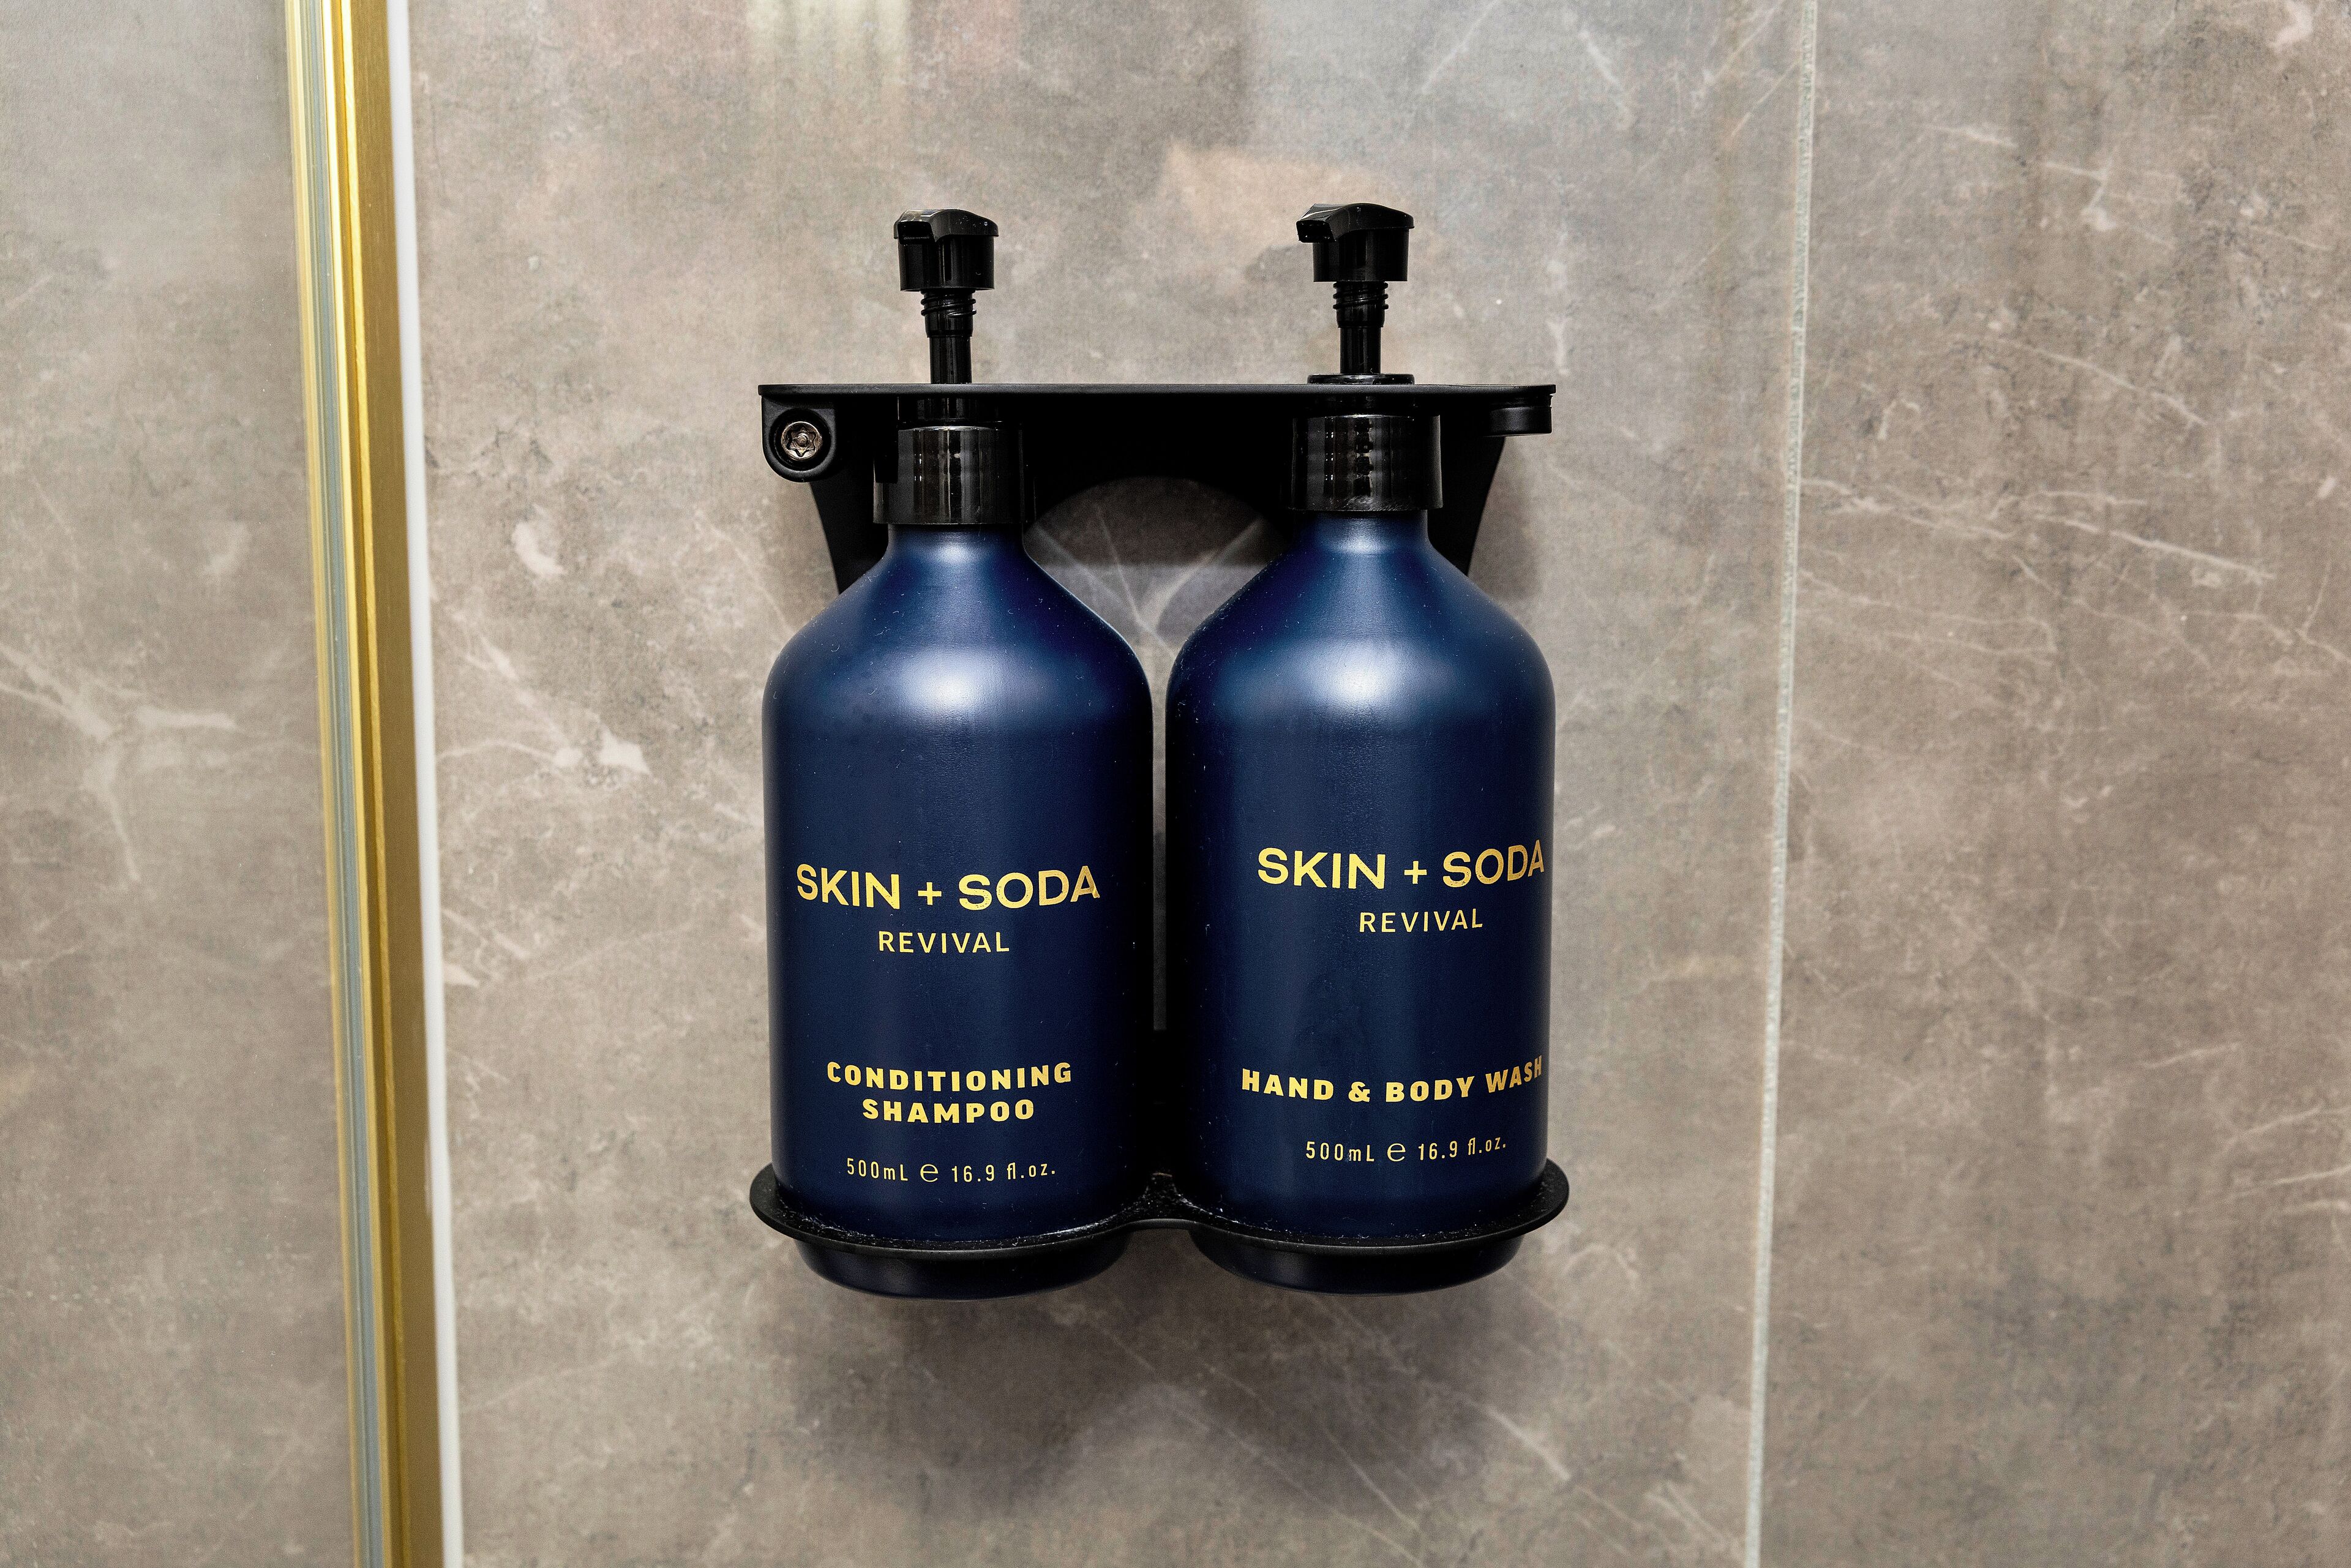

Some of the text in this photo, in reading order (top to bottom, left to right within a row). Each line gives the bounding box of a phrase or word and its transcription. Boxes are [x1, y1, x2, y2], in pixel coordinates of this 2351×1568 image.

[1258, 839, 1545, 889] SKIN + SODA
[797, 863, 1100, 910] SKIN + SODA
[1359, 908, 1483, 932] REVIVAL
[878, 931, 1010, 953] REVIVAL
[827, 1061, 1071, 1092] CONDITIONING
[1242, 1054, 1543, 1103] HAND & BODY WASH
[862, 1098, 1034, 1123] SHAMPOO
[1305, 1141, 1374, 1162] 500mL
[1418, 1141, 1458, 1161] 16.9
[847, 1157, 909, 1181] 500mL
[951, 1165, 995, 1182] 16.9
